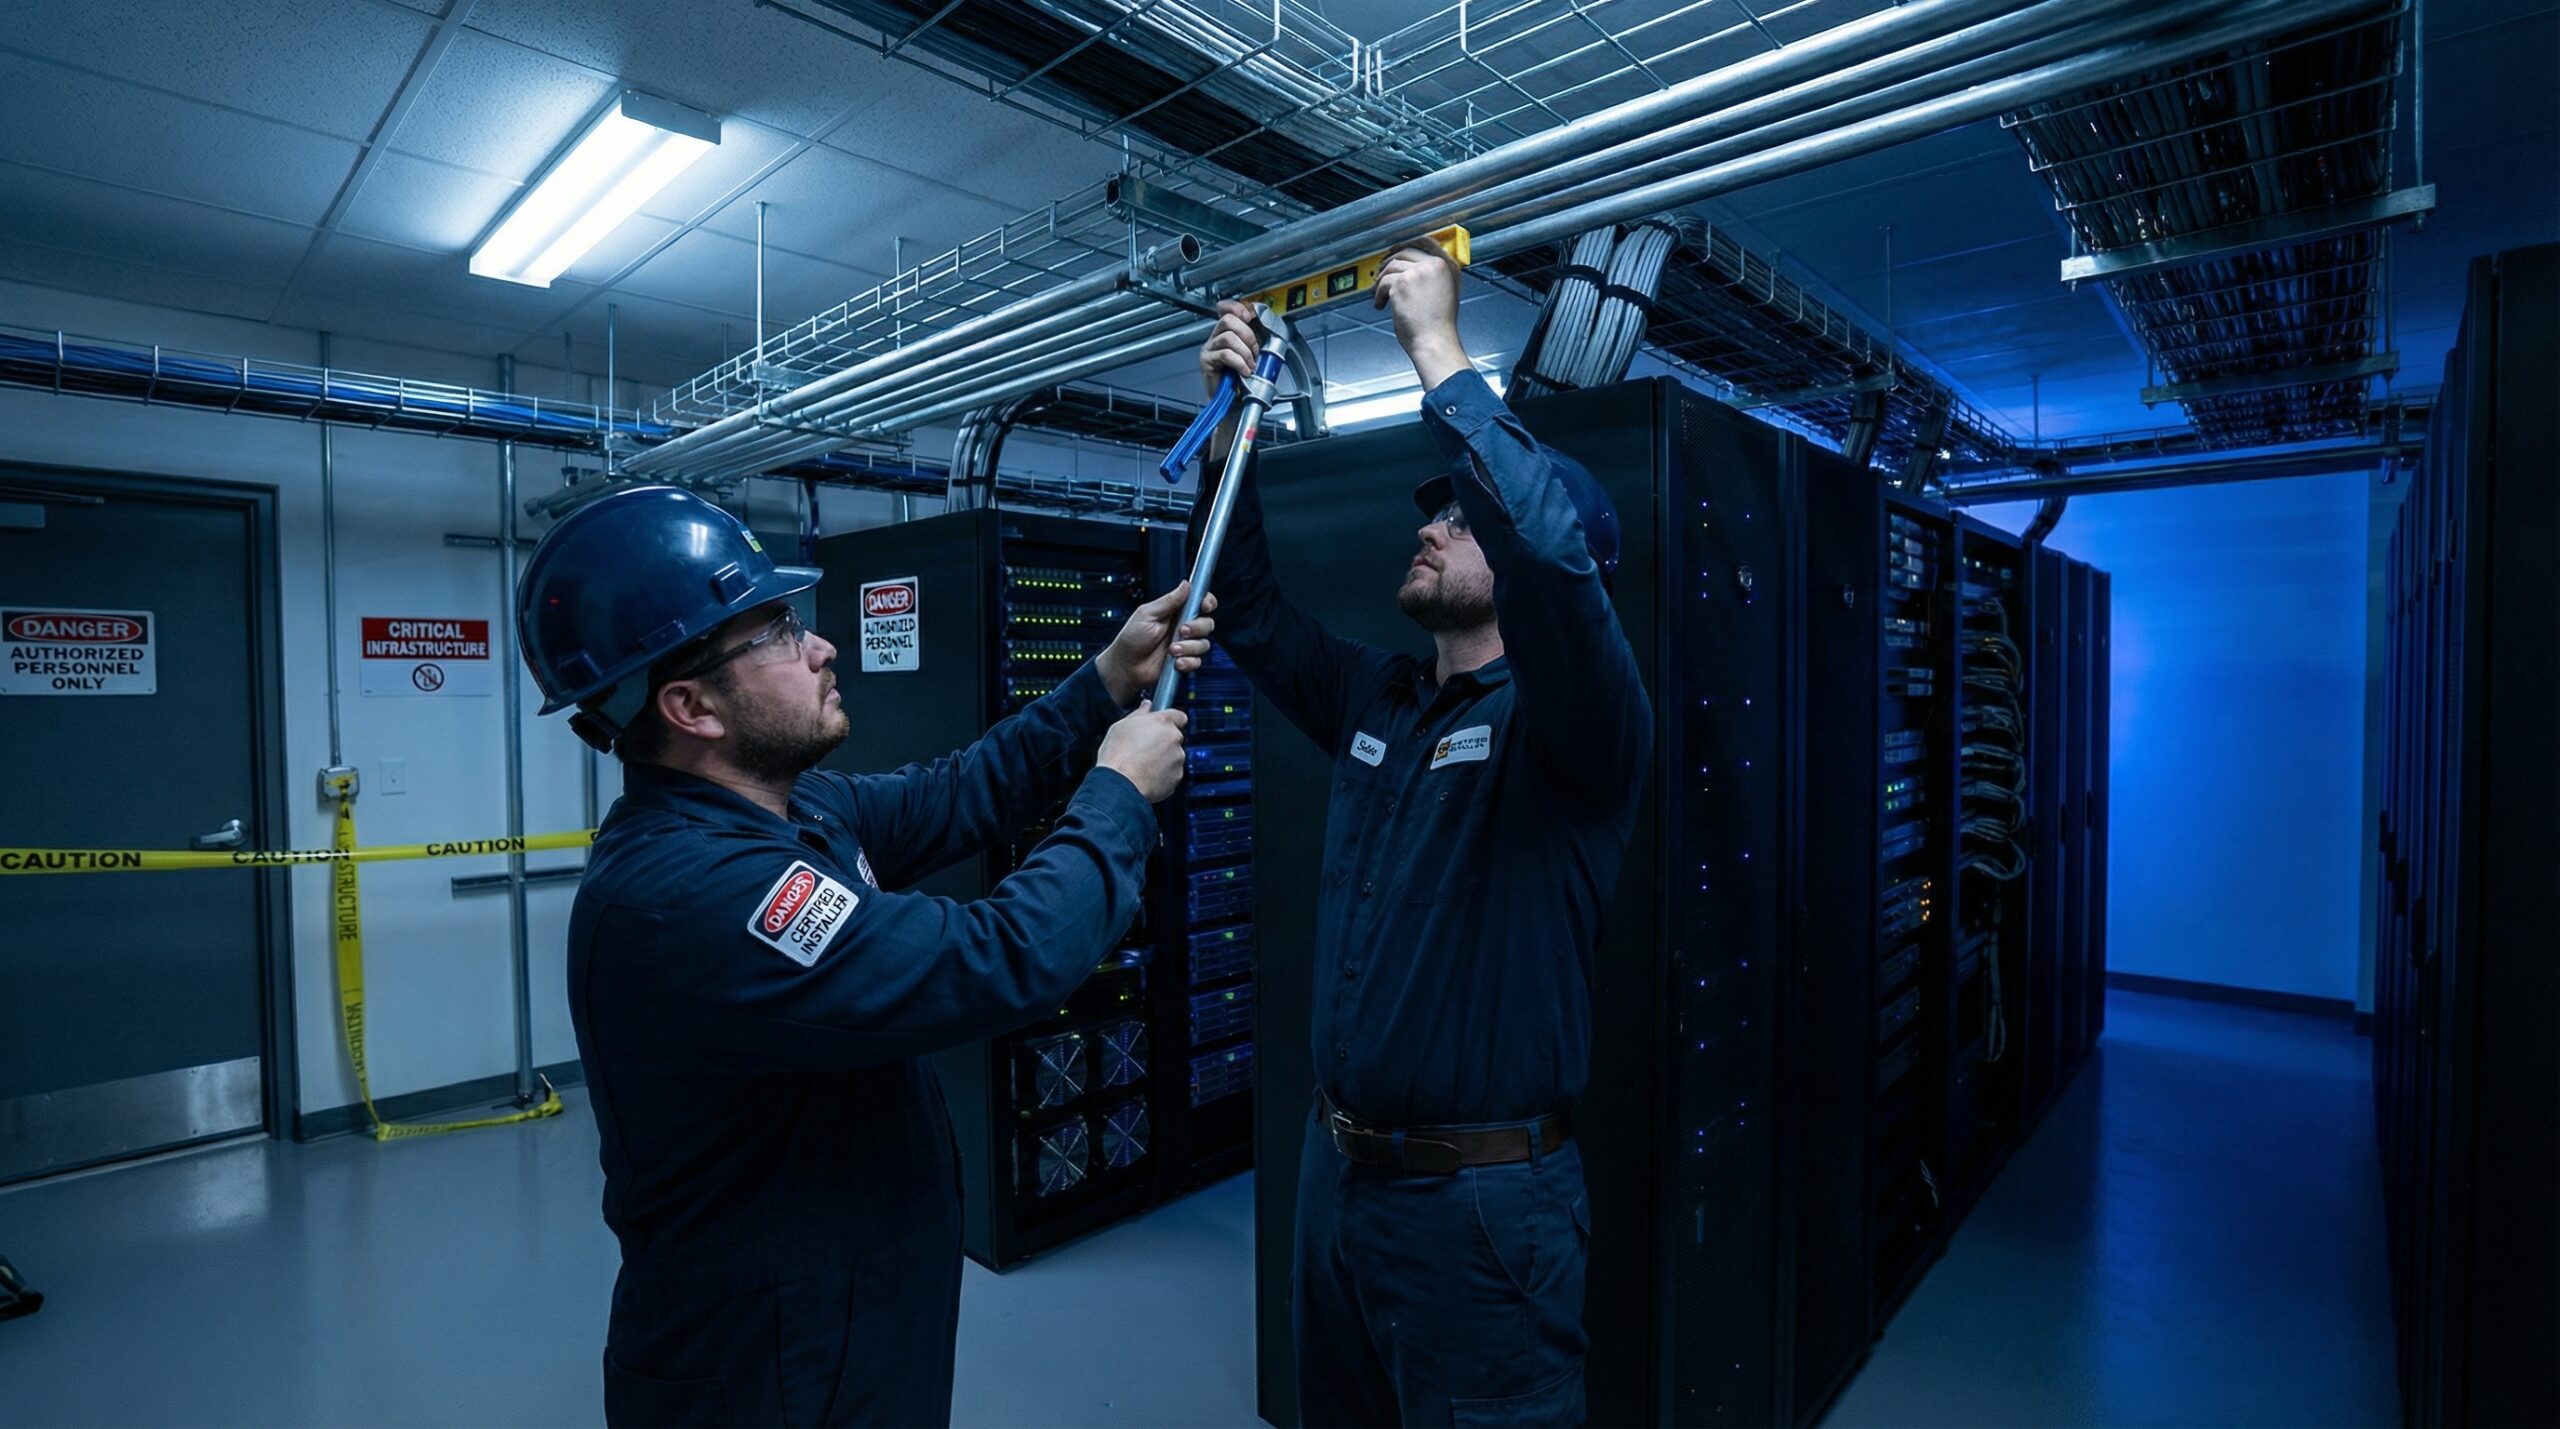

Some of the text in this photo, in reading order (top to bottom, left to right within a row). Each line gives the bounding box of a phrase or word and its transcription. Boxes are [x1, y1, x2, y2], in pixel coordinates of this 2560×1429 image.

[22, 619, 130, 638] DANGER
[388, 621, 465, 639] CRITICAL
[10, 646, 145, 661] AUTHORIZED
[366, 640, 487, 656] INFRASTRUCTURE
[14, 661, 141, 675] PERSONNEL
[52, 676, 106, 690] ONLY
[426, 838, 525, 856] CAUTION
[0, 851, 142, 870] CAUTION
[232, 849, 350, 864] CAUTION
[768, 875, 812, 929] DANGER
[800, 894, 849, 956] INSTALLER
